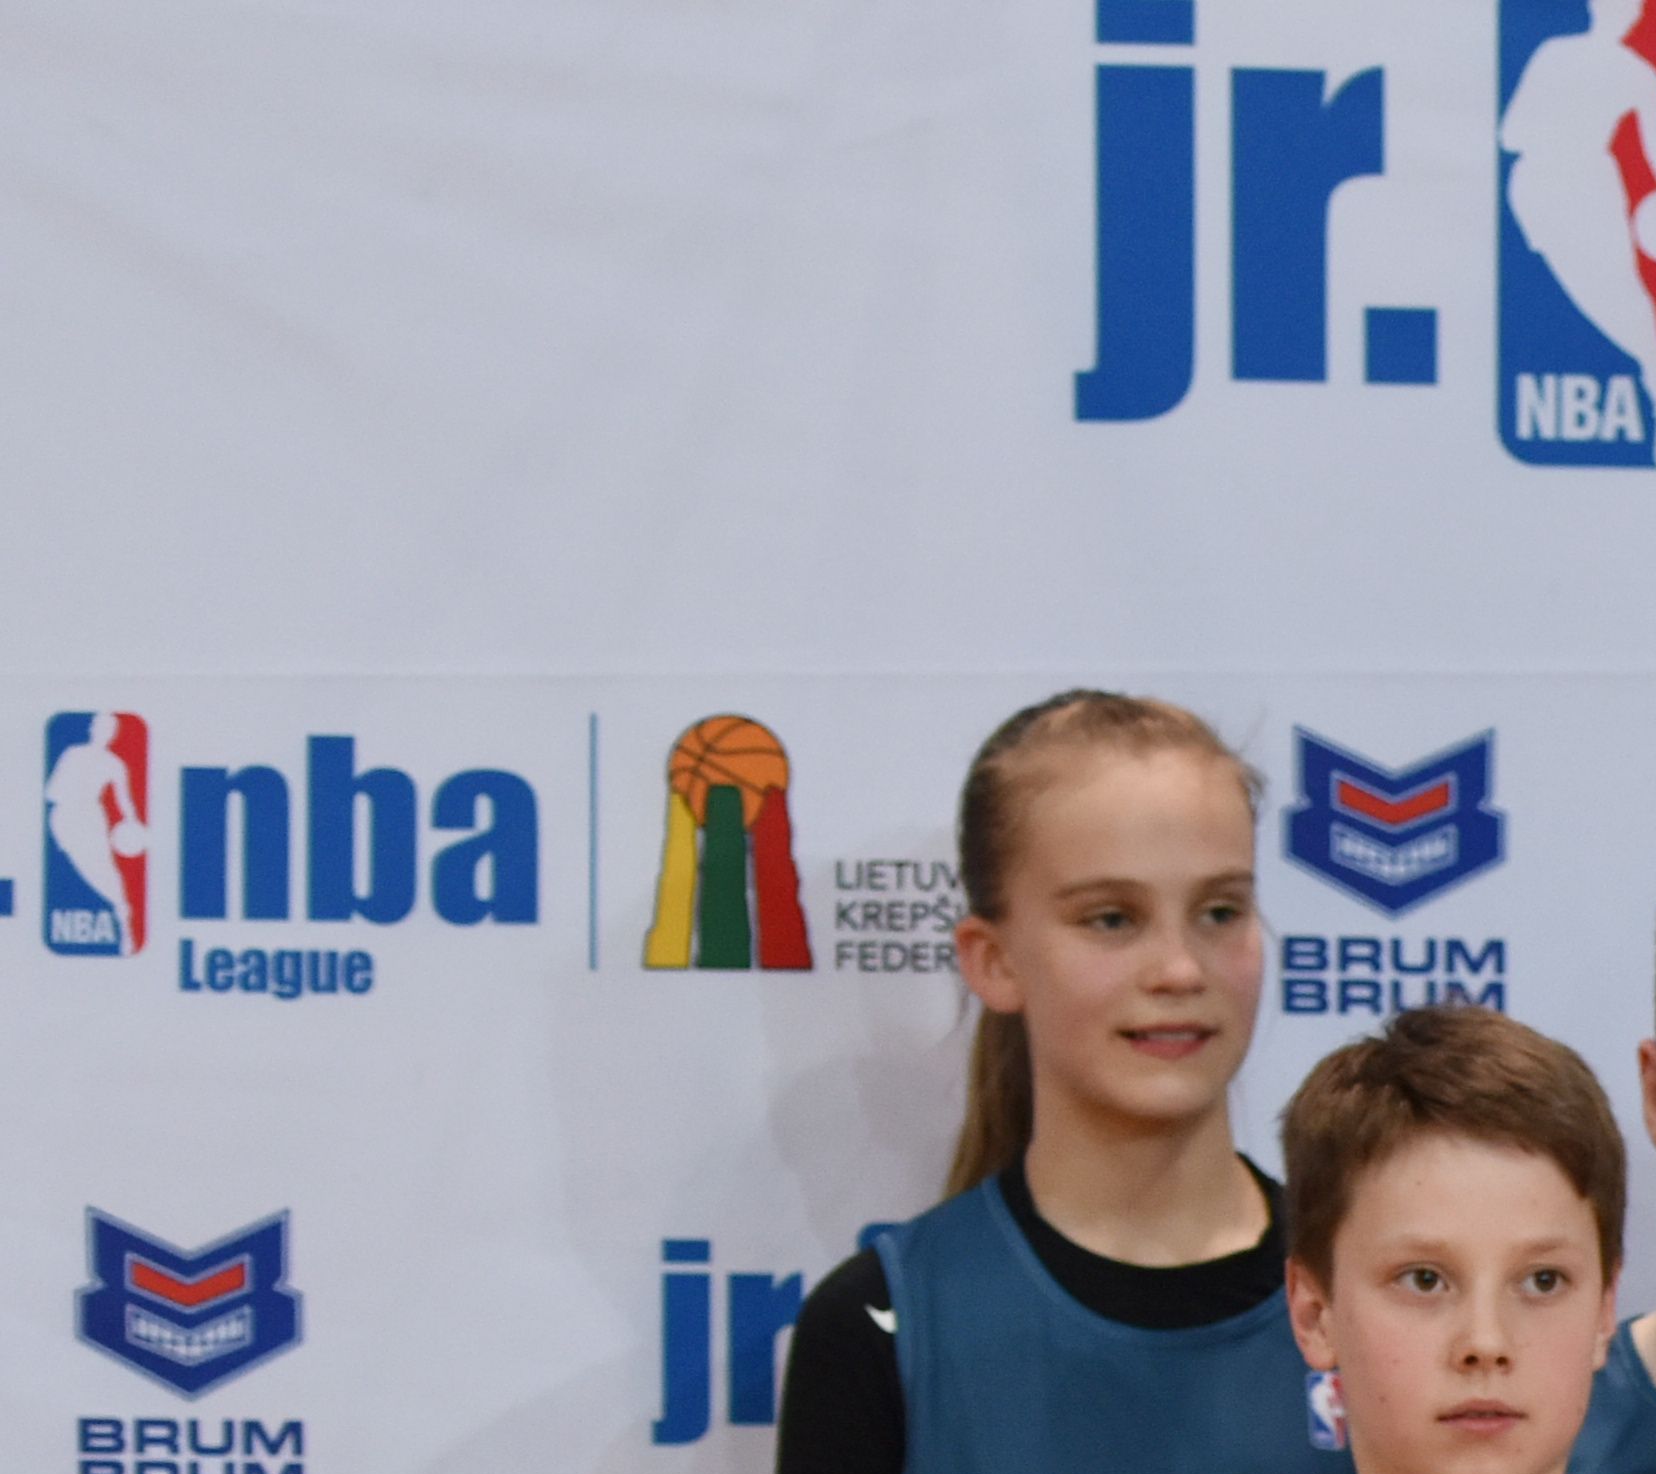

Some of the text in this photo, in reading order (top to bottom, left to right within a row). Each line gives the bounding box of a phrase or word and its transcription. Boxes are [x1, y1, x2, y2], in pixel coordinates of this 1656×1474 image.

[1075, 0, 1437, 422] jr.
[1516, 374, 1645, 444] NBA
[179, 734, 539, 926] nba
[835, 860, 956, 892] LIETUV
[835, 894, 956, 932] KREPŠ
[179, 938, 374, 999] League
[835, 941, 957, 972] FEDER
[1282, 936, 1505, 975] BRUM
[652, 1239, 804, 1444] jr
[77, 1418, 305, 1456] BRUM
